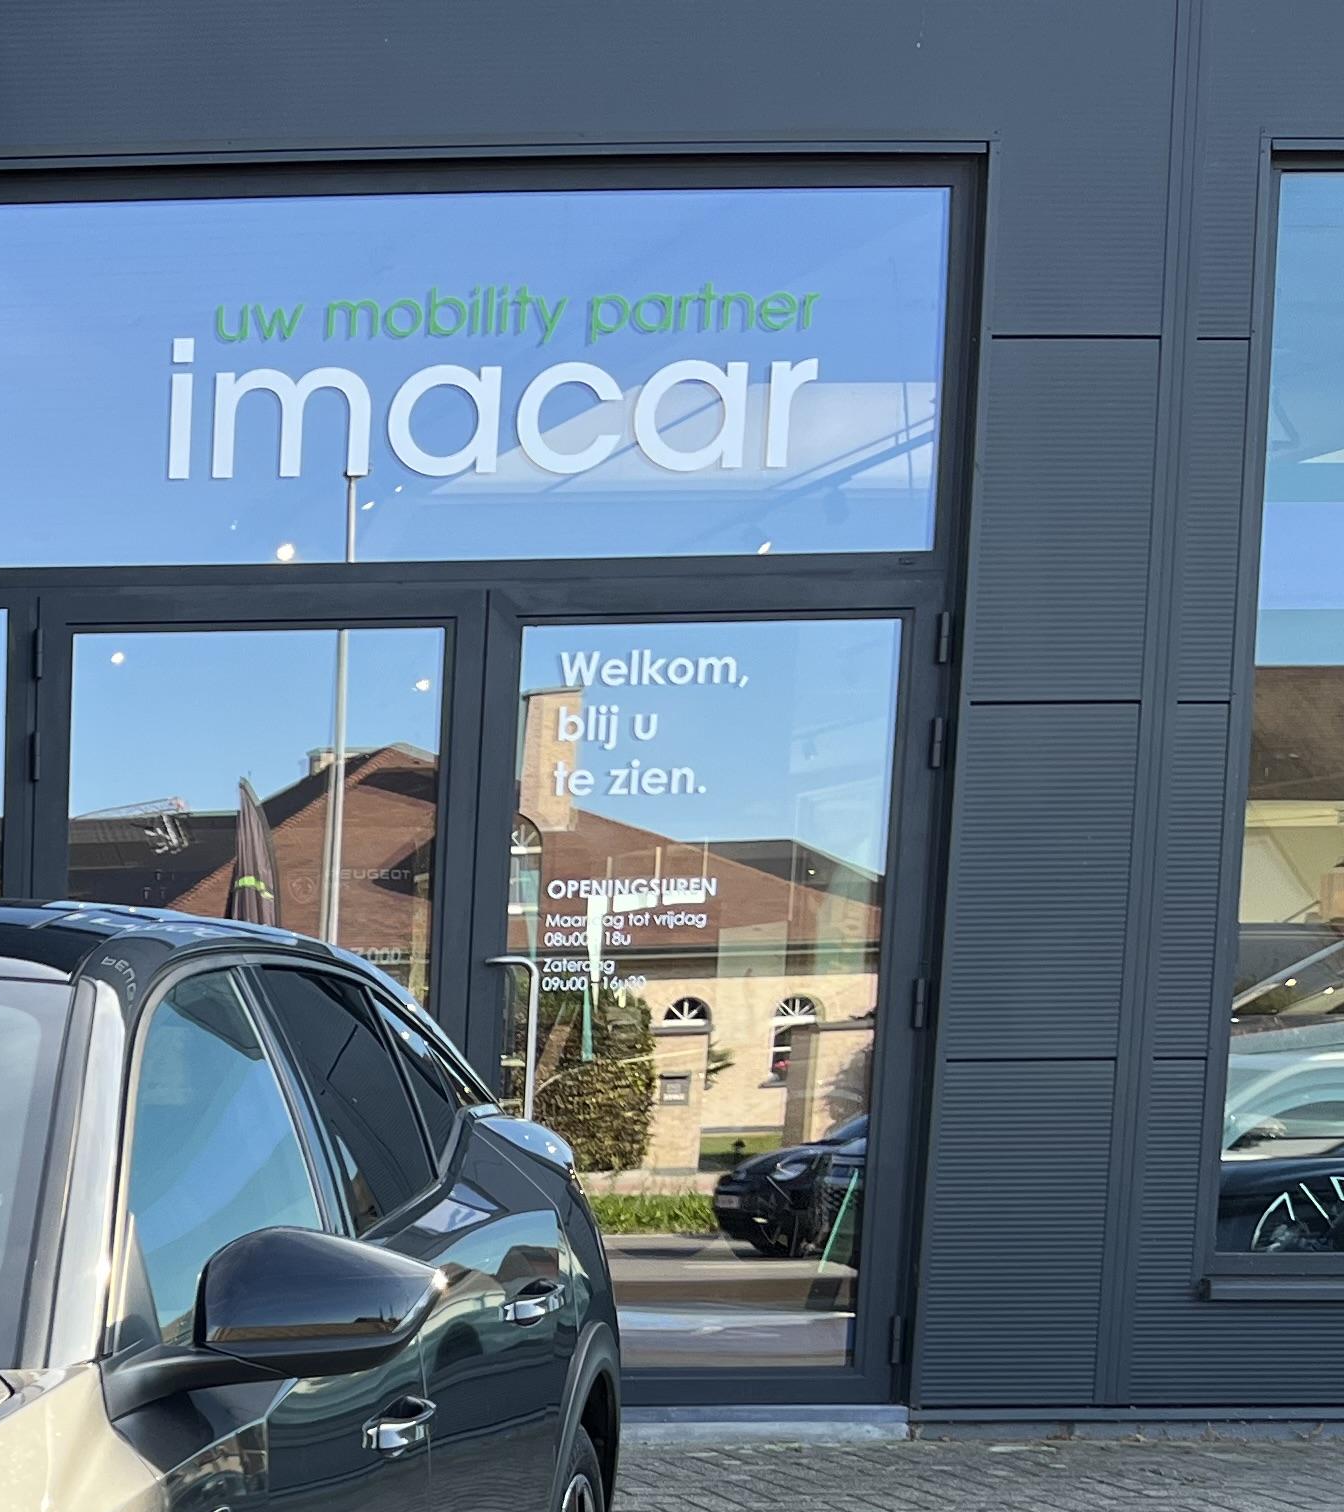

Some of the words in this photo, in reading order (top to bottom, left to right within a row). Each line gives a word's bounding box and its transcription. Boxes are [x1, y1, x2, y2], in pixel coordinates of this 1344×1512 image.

[216, 304, 303, 342] uw
[327, 285, 568, 344] mobility
[590, 283, 820, 344] partner
[167, 337, 819, 480] imacar
[560, 649, 749, 689] Welkom,
[558, 704, 619, 750] blij
[633, 714, 658, 741] u
[554, 760, 594, 797] te
[607, 759, 707, 796] zien.
[341, 868, 411, 880] EUGEOT
[547, 877, 717, 899] OPENINGSUREN
[628, 912, 650, 927] tot
[655, 911, 707, 929] vrijdag
[604, 930, 632, 946] 18u
[542, 977, 588, 992] 09u00
